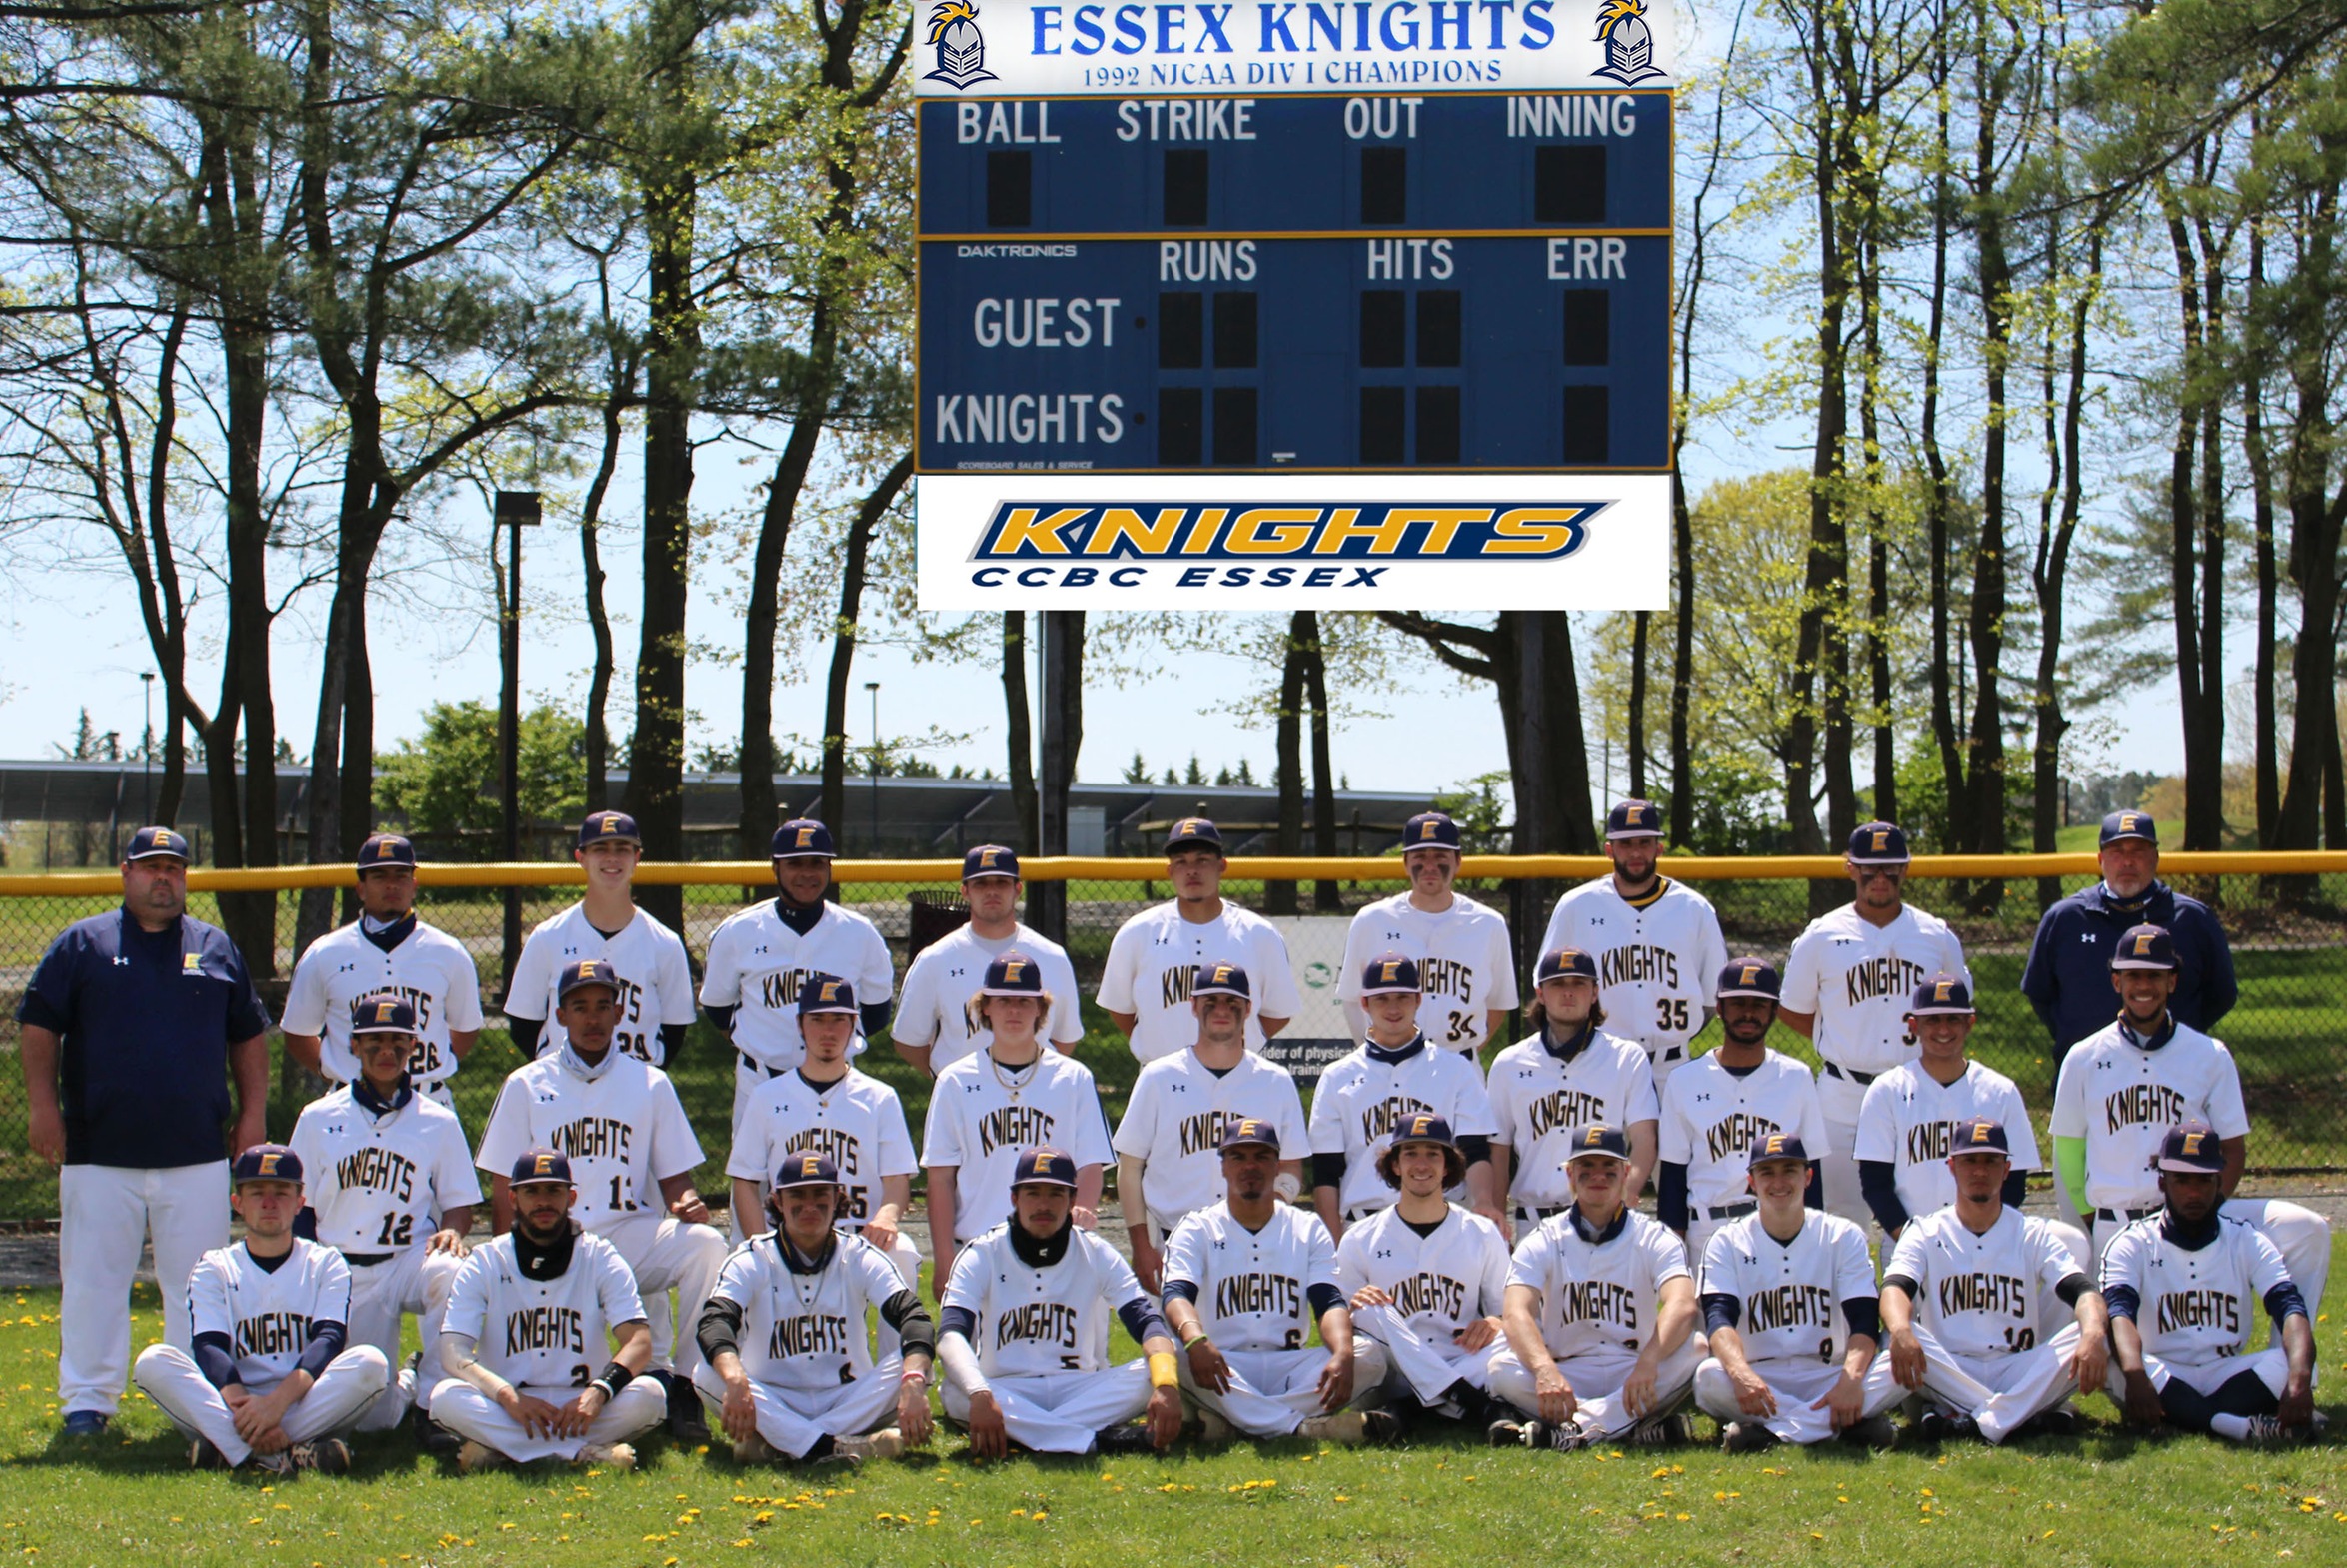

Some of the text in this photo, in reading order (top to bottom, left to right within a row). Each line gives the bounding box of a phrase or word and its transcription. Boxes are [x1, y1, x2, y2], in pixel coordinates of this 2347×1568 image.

[1030, 0, 1555, 56] ESSEX KNIGHTS
[1084, 59, 1502, 87] 1992 NJCAA DIV I CHAMPIONS
[957, 101, 1062, 144] BALL
[1116, 99, 1257, 142] STRIKE
[1344, 97, 1424, 140] OUT
[1507, 95, 1636, 138] INNING
[957, 245, 1078, 258] DAKTRONICS
[1160, 240, 1257, 281] RUNS
[1367, 238, 1454, 280] HITS
[1548, 237, 1627, 280] ERR
[974, 298, 1121, 347] GUEST
[936, 394, 1125, 444] KNIGHTS
[957, 461, 1014, 470] SCOREBOARD
[1017, 461, 1044, 470] SALES
[1058, 461, 1094, 470] SERVICE
[988, 507, 1587, 555] KNIGHTS
[970, 567, 1392, 588] CCBC ESSEX
[601, 816, 621, 833] E
[1625, 806, 1645, 825] E
[2118, 815, 2138, 832] E
[152, 830, 172, 847] E
[795, 828, 816, 848] E
[1180, 821, 1199, 835] E
[1419, 821, 1439, 840] E
[377, 840, 397, 858] E
[1871, 831, 1889, 852] E
[980, 849, 1000, 868] E
[2133, 935, 2155, 955] E
[578, 960, 599, 979] E
[1558, 951, 1577, 969] E
[1601, 945, 1679, 990] KNIGHTS
[1003, 962, 1026, 983] E
[1212, 966, 1234, 984] E
[1380, 961, 1401, 982] E
[1739, 966, 1761, 985] E
[819, 982, 841, 1001] E
[1933, 982, 1955, 1002] E
[375, 1003, 397, 1023] E
[1656, 998, 1689, 1032] 35
[408, 1041, 441, 1075] 26
[1290, 1046, 1303, 1059] of
[1237, 1120, 1261, 1137] E
[1410, 1117, 1434, 1136] E
[1584, 1127, 1608, 1146] E
[1971, 1123, 1994, 1143] E
[1765, 1135, 1788, 1155] E
[2181, 1133, 2206, 1155] E
[259, 1153, 281, 1175] E
[533, 1154, 556, 1175] E
[801, 1156, 821, 1178] E
[1032, 1152, 1058, 1174] E
[377, 1211, 414, 1245] 12
[1216, 1273, 1299, 1320] KNIGHTS
[1940, 1272, 2025, 1319] KNIGHTS
[1747, 1285, 1830, 1335] KNIGHTS
[2158, 1290, 2239, 1335] KNIGHTS
[997, 1302, 1077, 1351] KNIGHTS
